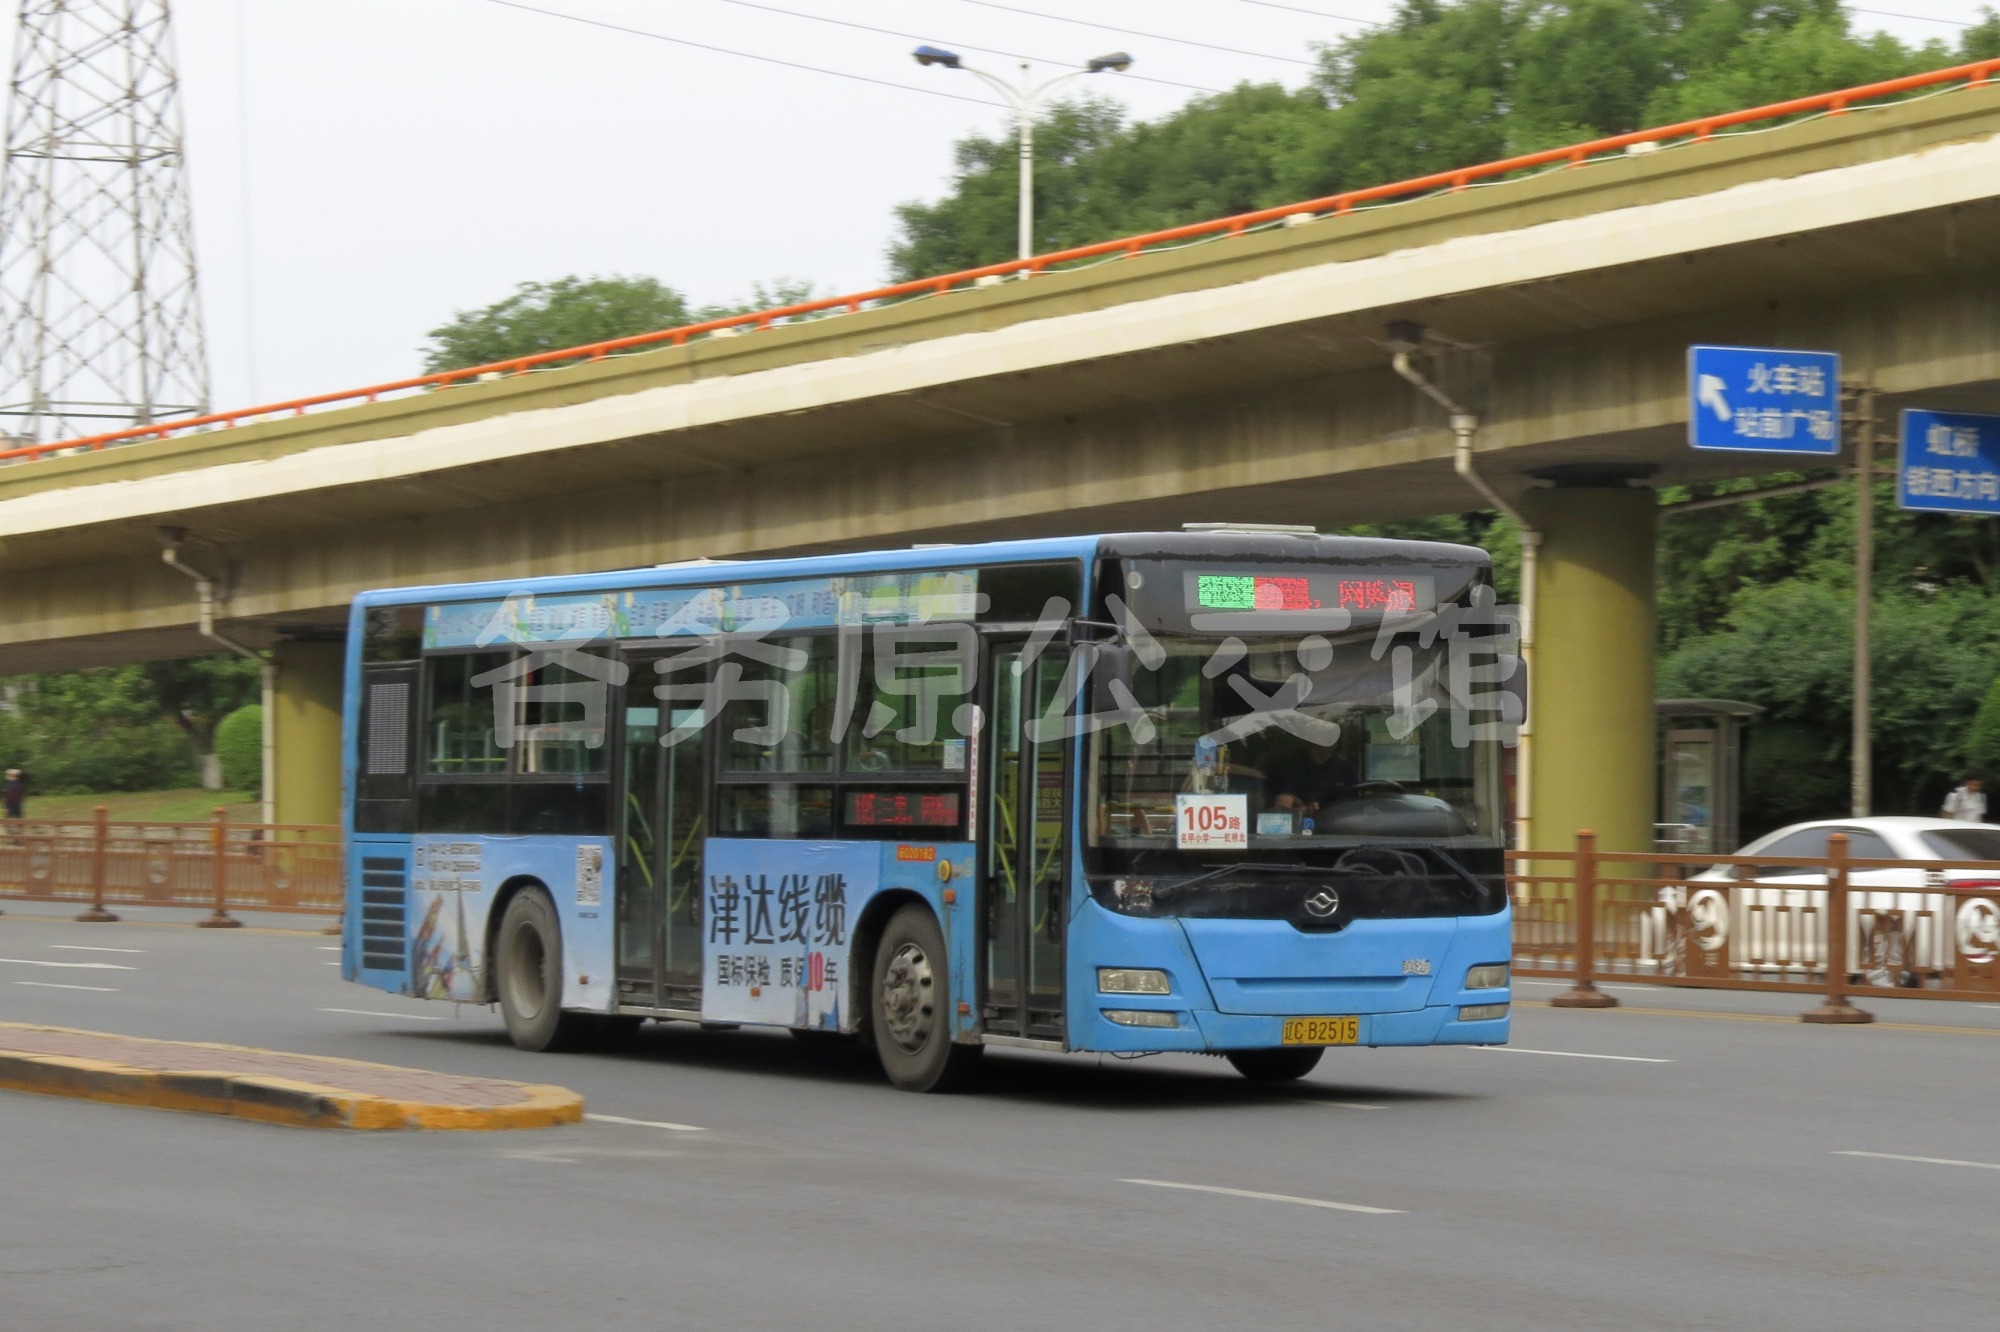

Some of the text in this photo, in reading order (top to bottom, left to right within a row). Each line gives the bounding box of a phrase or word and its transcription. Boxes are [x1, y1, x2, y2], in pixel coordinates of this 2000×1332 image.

[1745, 362, 1825, 397] 火车站
[1183, 805, 1241, 832] 105路
[709, 873, 847, 948] 津达线缆
[717, 954, 771, 987] 国标保检
